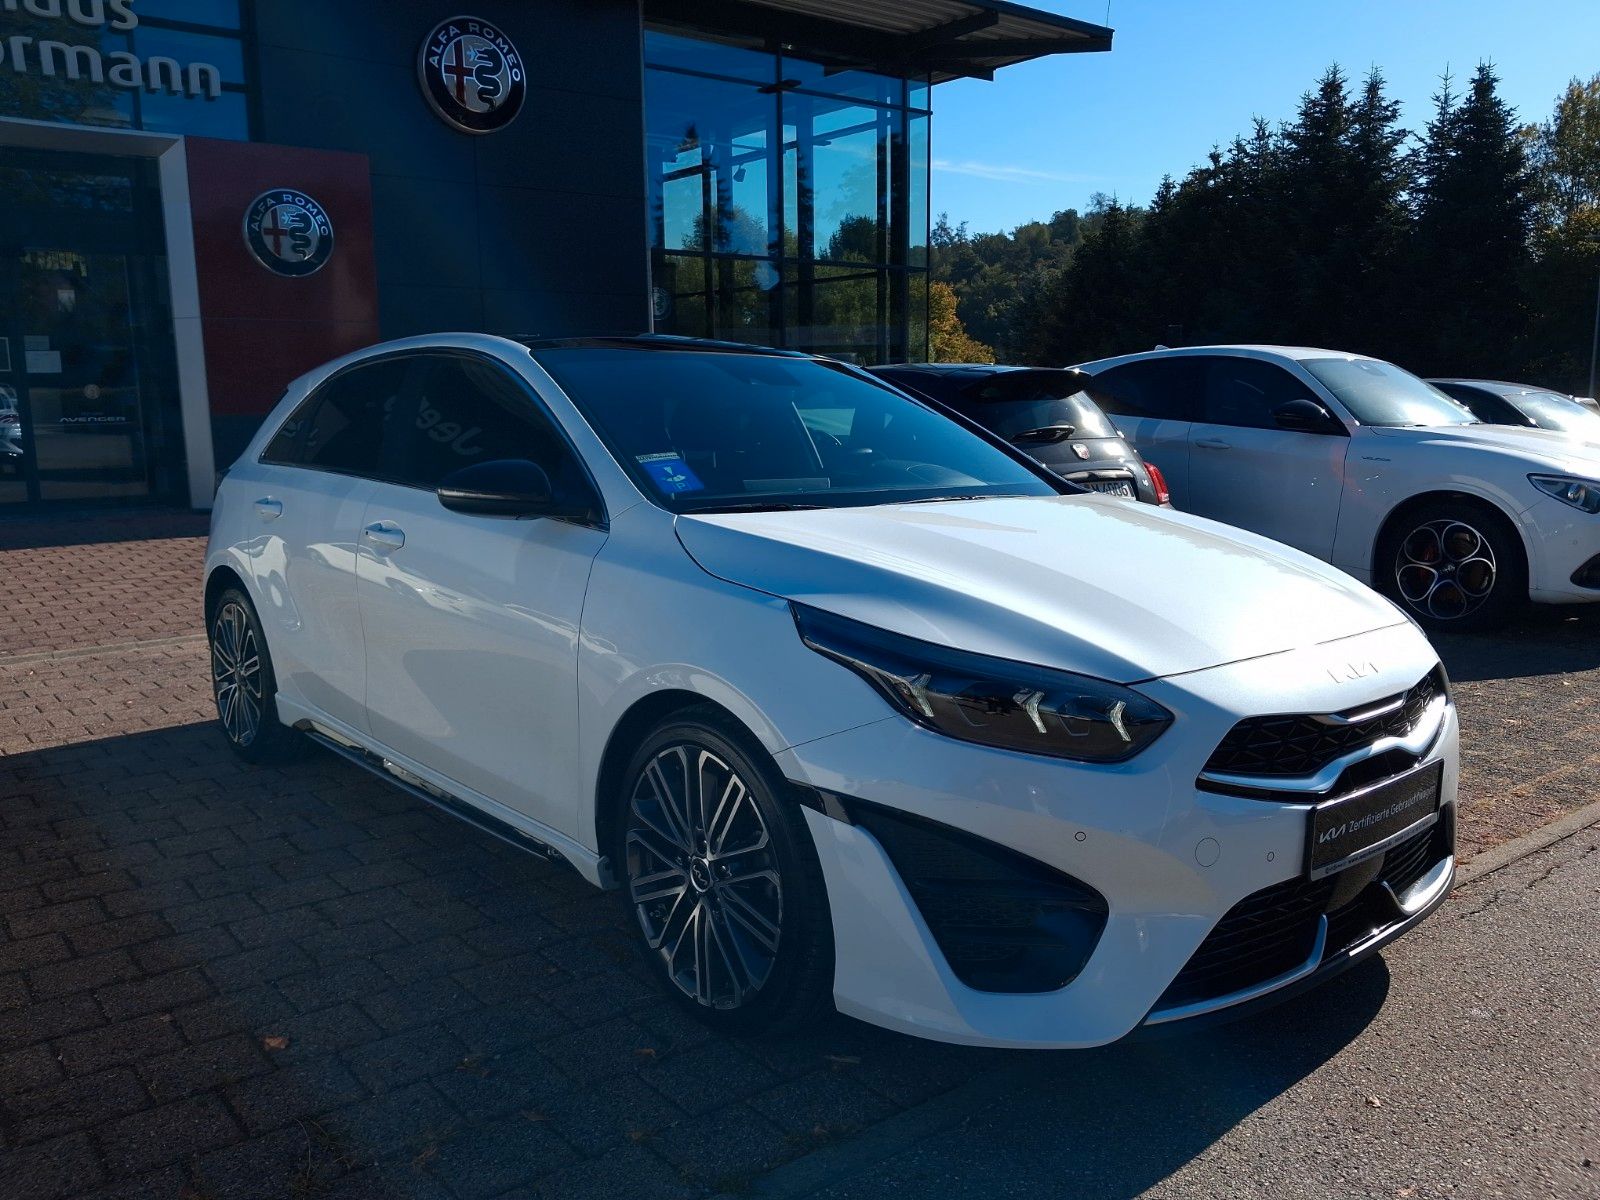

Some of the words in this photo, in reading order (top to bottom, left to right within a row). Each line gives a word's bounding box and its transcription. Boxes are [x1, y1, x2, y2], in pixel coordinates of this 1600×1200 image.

[3, 0, 139, 30] aus
[0, 35, 222, 97] rmann
[429, 25, 461, 68] ALFA
[468, 22, 521, 82] ROMEO
[251, 197, 276, 231] ALFA
[282, 194, 329, 236] ROMEO
[1349, 808, 1390, 833] Zertifizierte
